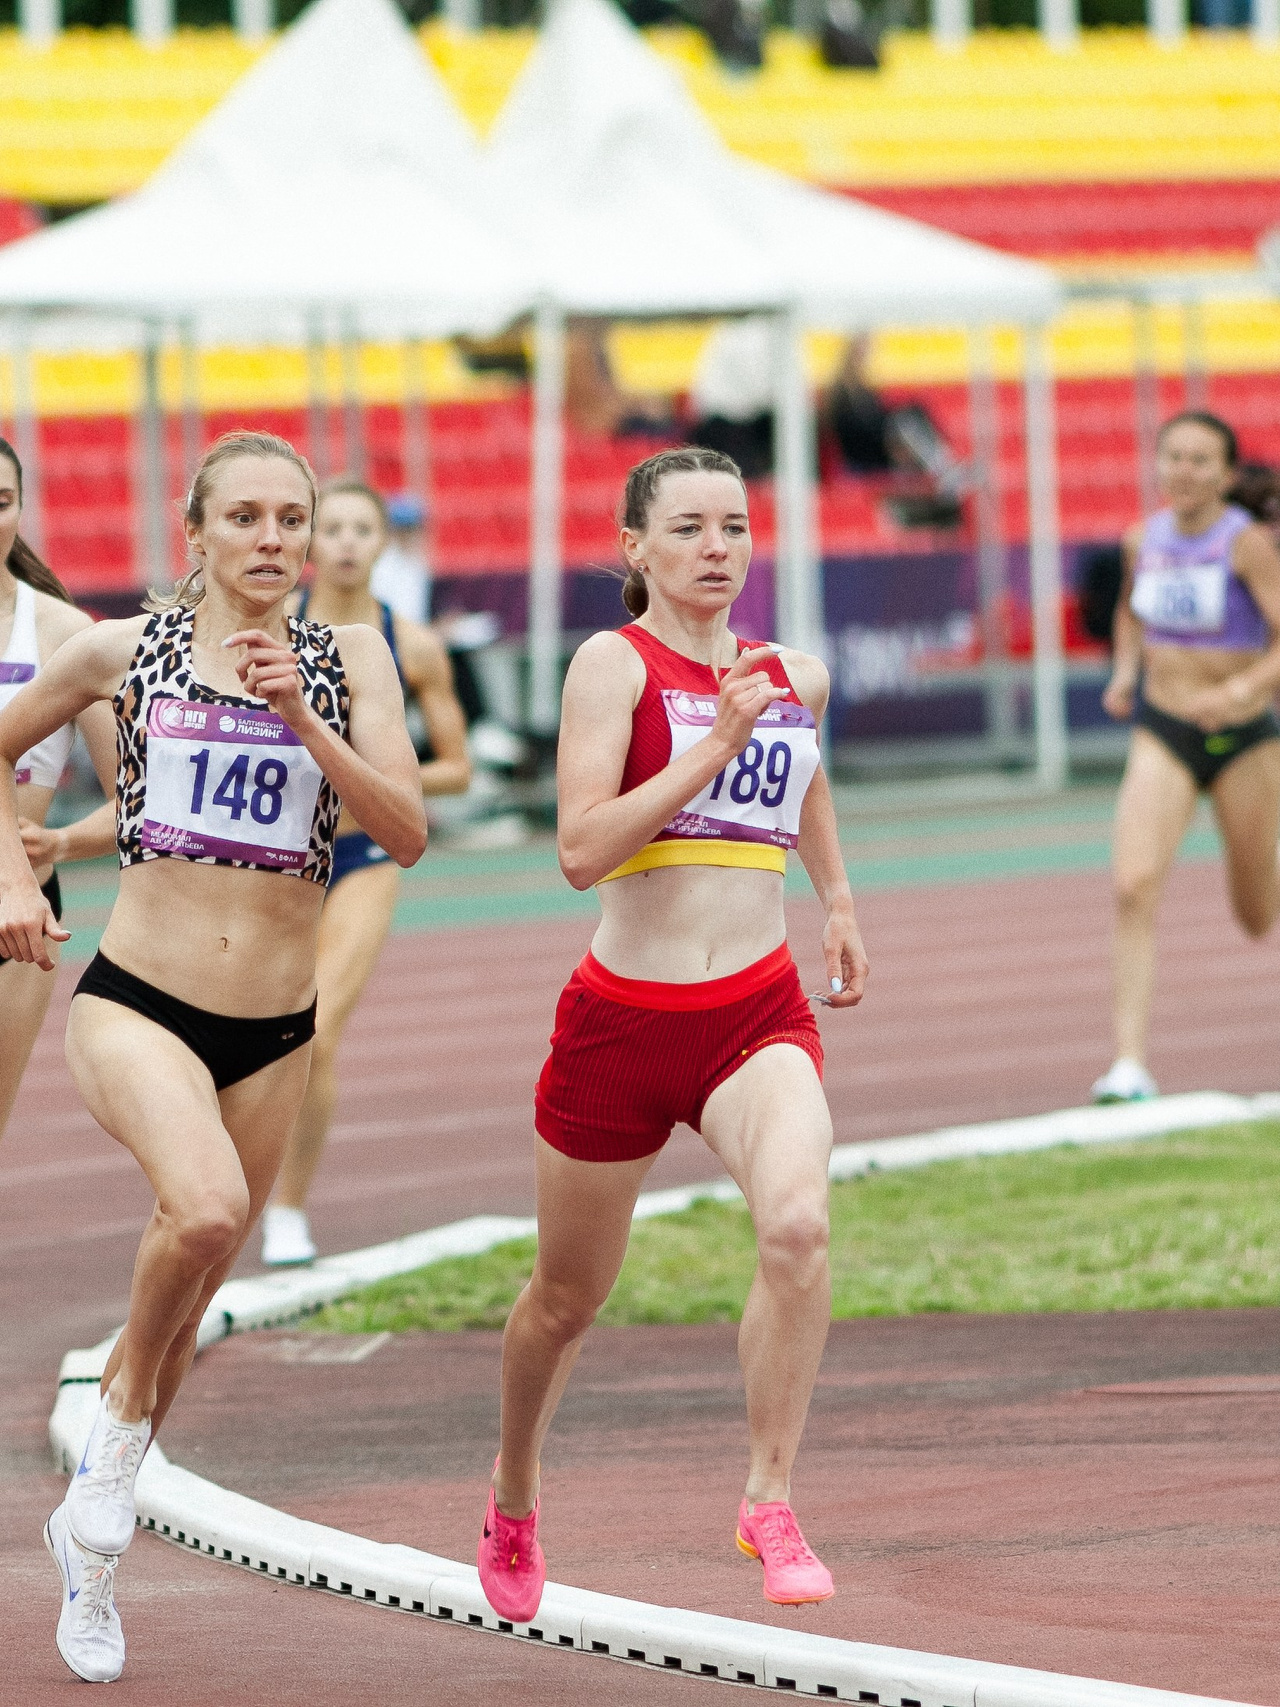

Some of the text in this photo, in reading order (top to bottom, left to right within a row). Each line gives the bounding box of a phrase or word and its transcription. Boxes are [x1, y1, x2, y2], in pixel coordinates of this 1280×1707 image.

[236, 724, 283, 739] ЛИЗИНГ
[238, 718, 284, 730] БАЛТИЙСКИЙ
[189, 748, 288, 825] 148
